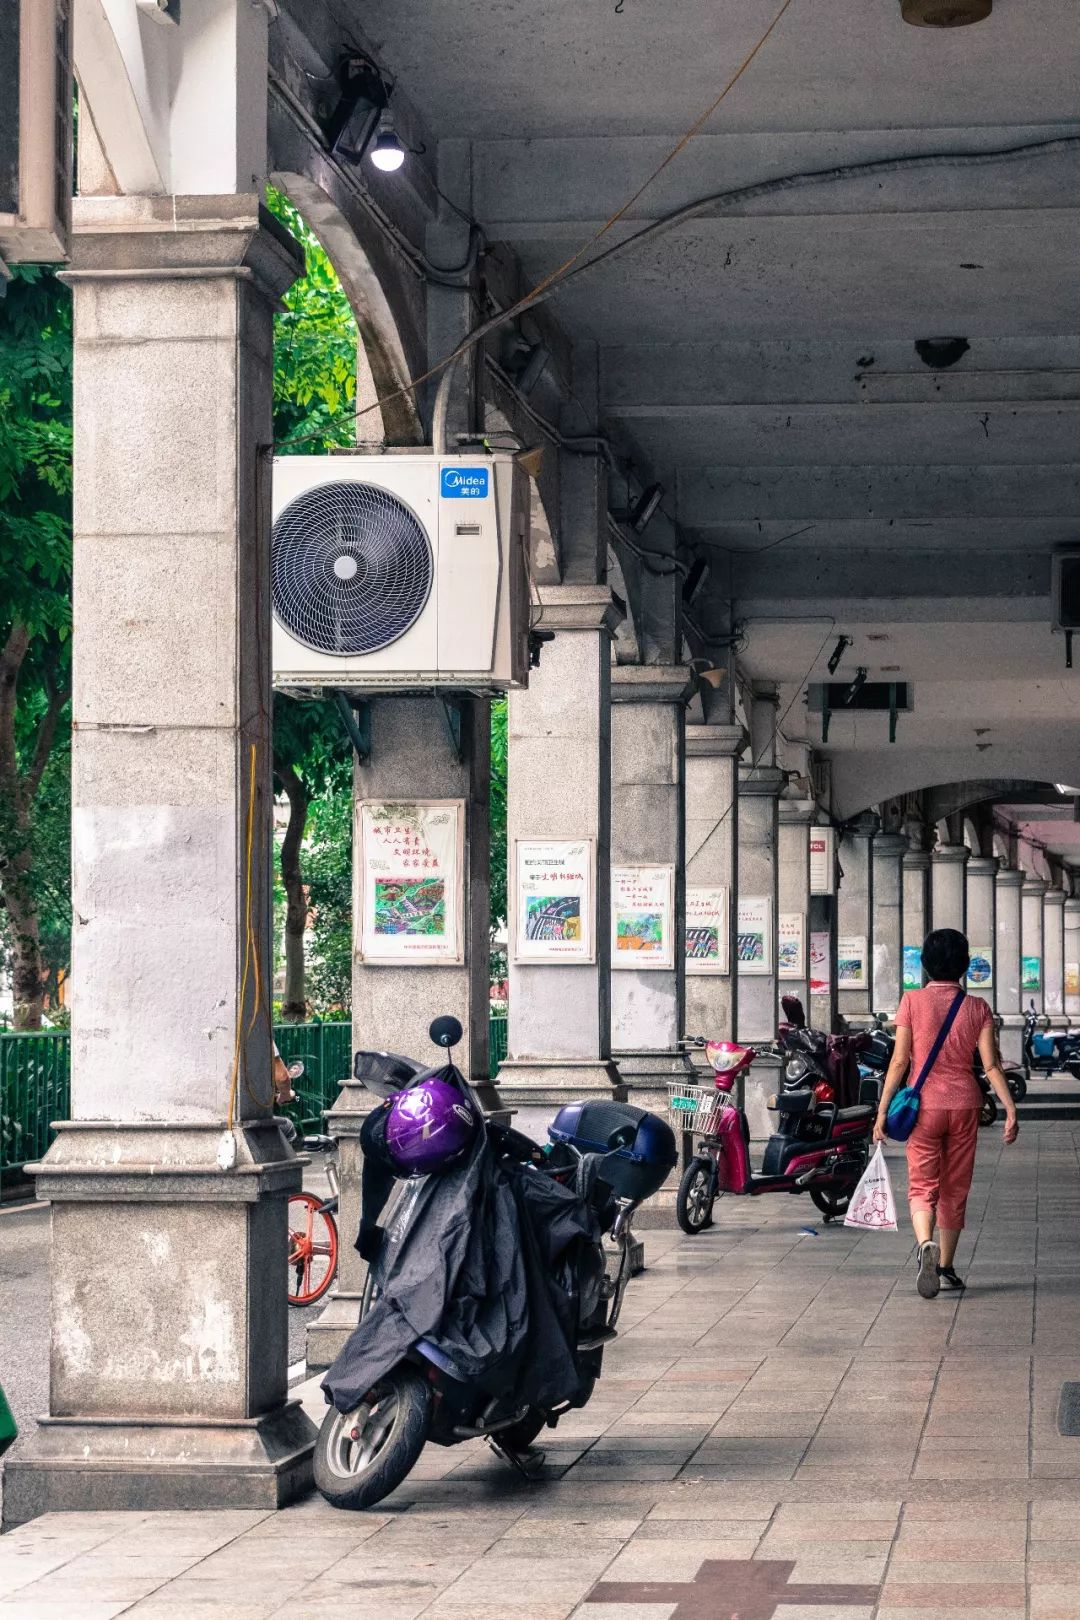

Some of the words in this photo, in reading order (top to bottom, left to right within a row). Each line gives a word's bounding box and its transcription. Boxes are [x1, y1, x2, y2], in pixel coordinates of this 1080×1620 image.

[451, 475, 485, 485] Midea
[460, 487, 480, 496] 美的
[372, 826, 411, 835] 城市卫生
[382, 837, 420, 846] 人人有责
[392, 848, 431, 857] 文明环境
[402, 858, 439, 868] 家家受益
